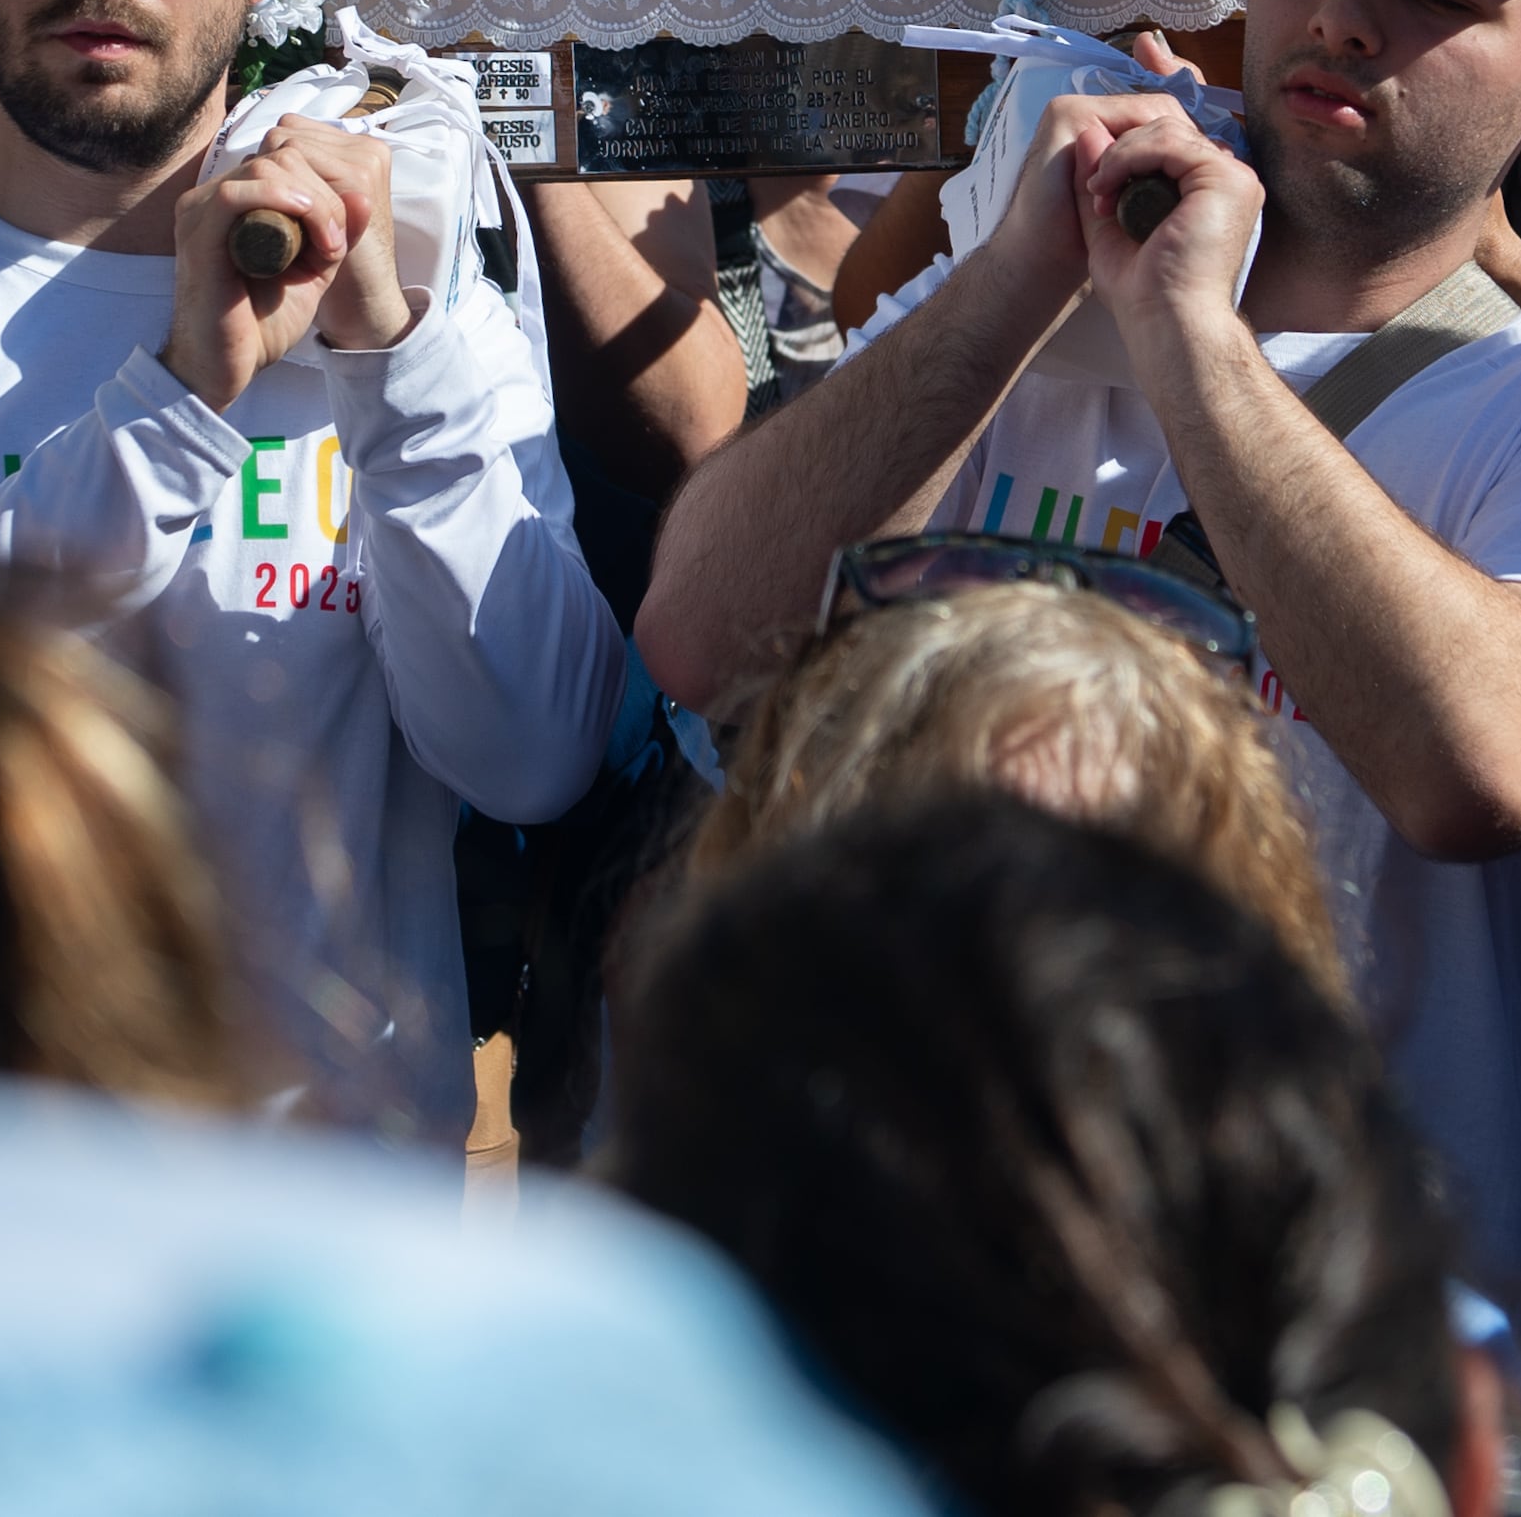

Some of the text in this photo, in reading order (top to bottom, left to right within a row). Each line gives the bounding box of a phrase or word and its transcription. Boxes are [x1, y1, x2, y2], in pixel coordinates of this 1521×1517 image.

[478, 74, 540, 88] AFERRERE
[812, 69, 846, 86] POR
[856, 68, 875, 85] EL
[516, 88, 529, 100] 50
[702, 93, 797, 112] FRANCISCO
[807, 90, 867, 108] 25-7-13
[752, 114, 779, 131] RIO
[788, 114, 810, 130] DE
[819, 112, 890, 129] JANEIRO
[495, 134, 541, 149] JUSTO
[599, 138, 678, 159] JORNADA
[803, 135, 825, 153] LA
[833, 131, 919, 151] JUVENTUD
[256, 562, 360, 613] 2025
